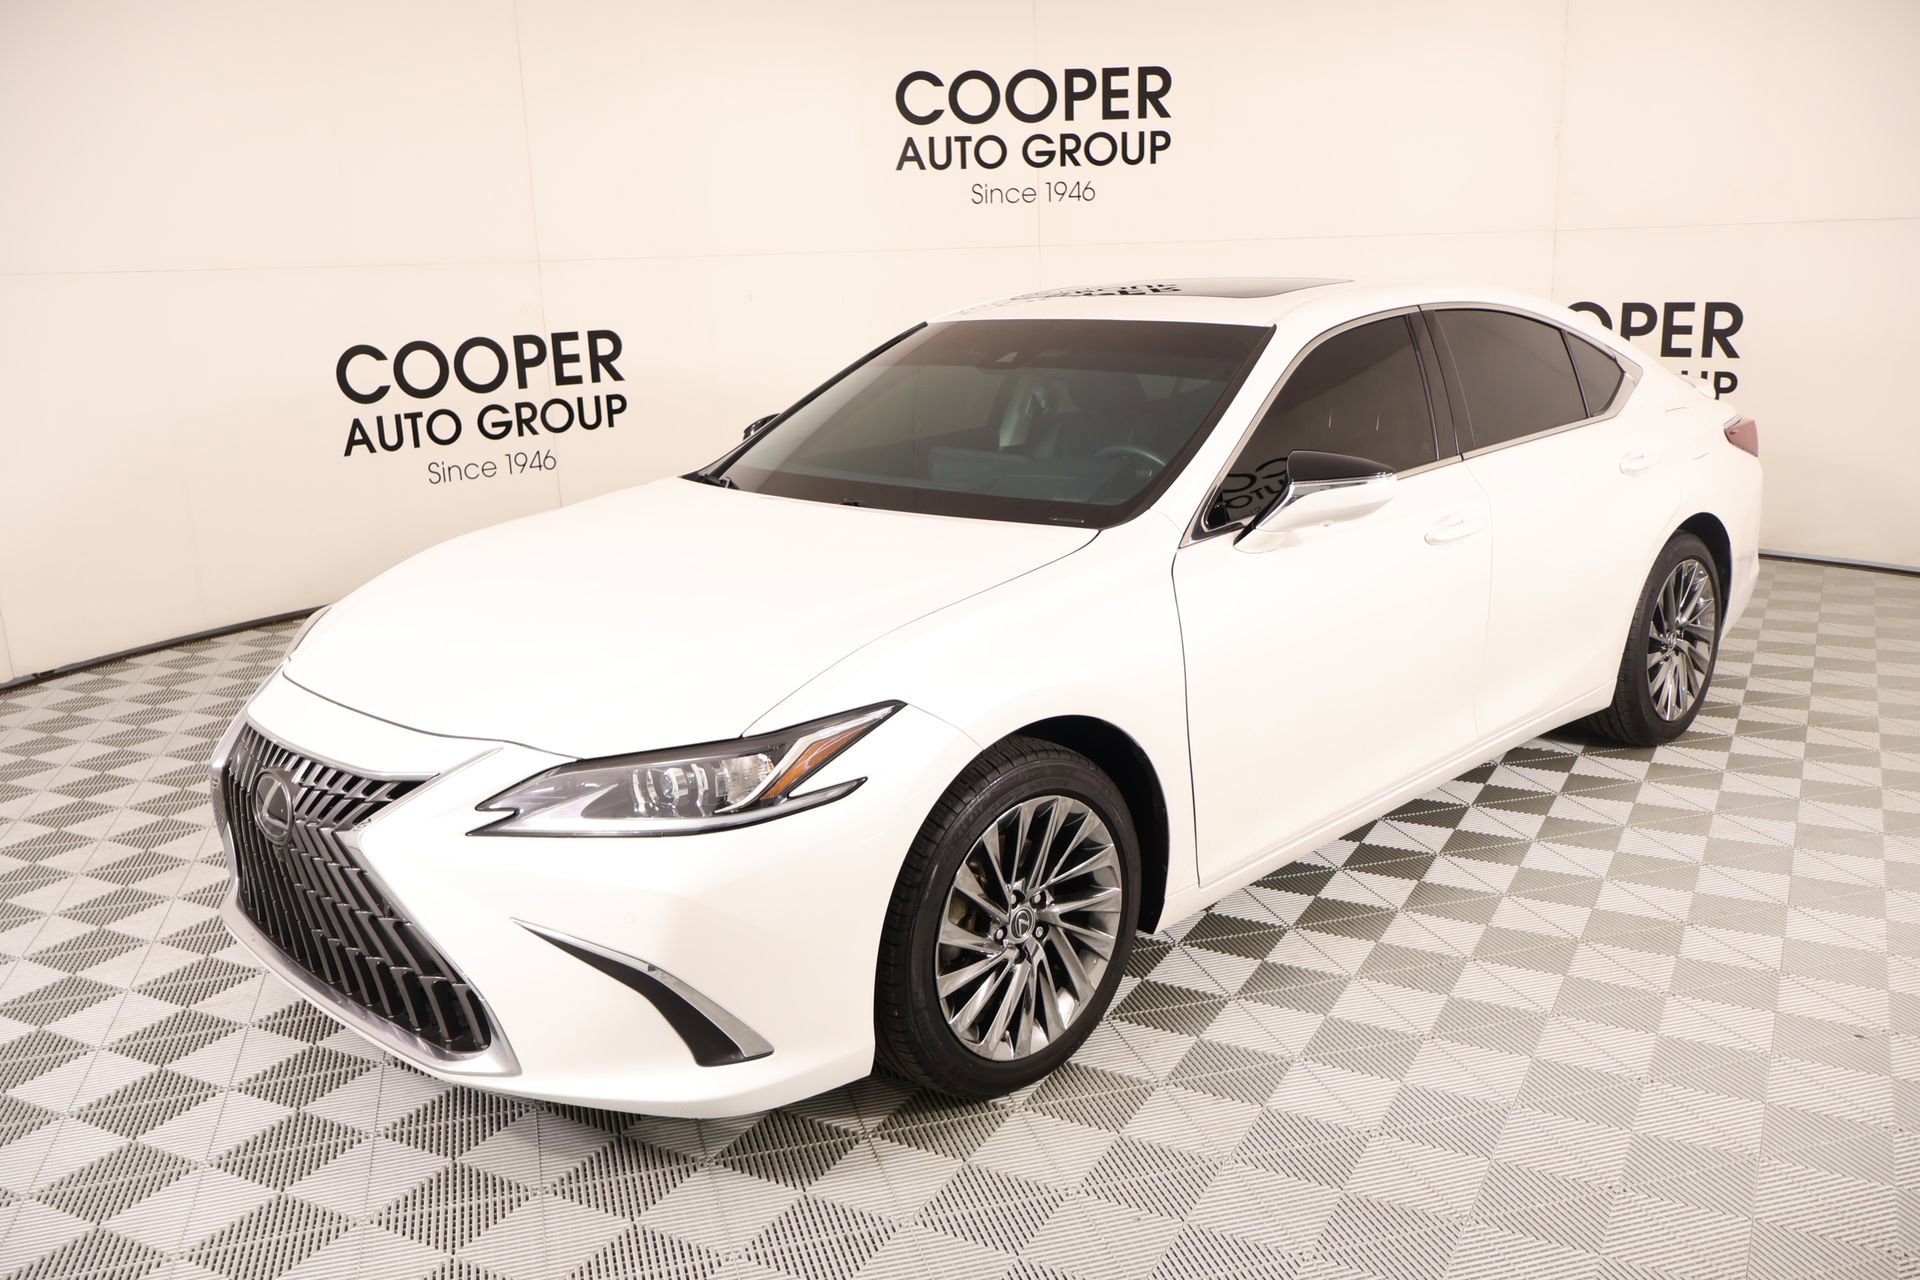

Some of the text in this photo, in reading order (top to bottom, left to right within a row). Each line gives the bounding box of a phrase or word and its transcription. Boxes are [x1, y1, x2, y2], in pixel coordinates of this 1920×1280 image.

[896, 66, 1172, 126] COOPER
[895, 130, 1172, 171] AUTO GROUP
[971, 181, 1096, 205] Since 1946
[336, 329, 625, 404] COOPER
[344, 394, 627, 457] AUTO GROUP
[428, 449, 557, 485] Since 1946
